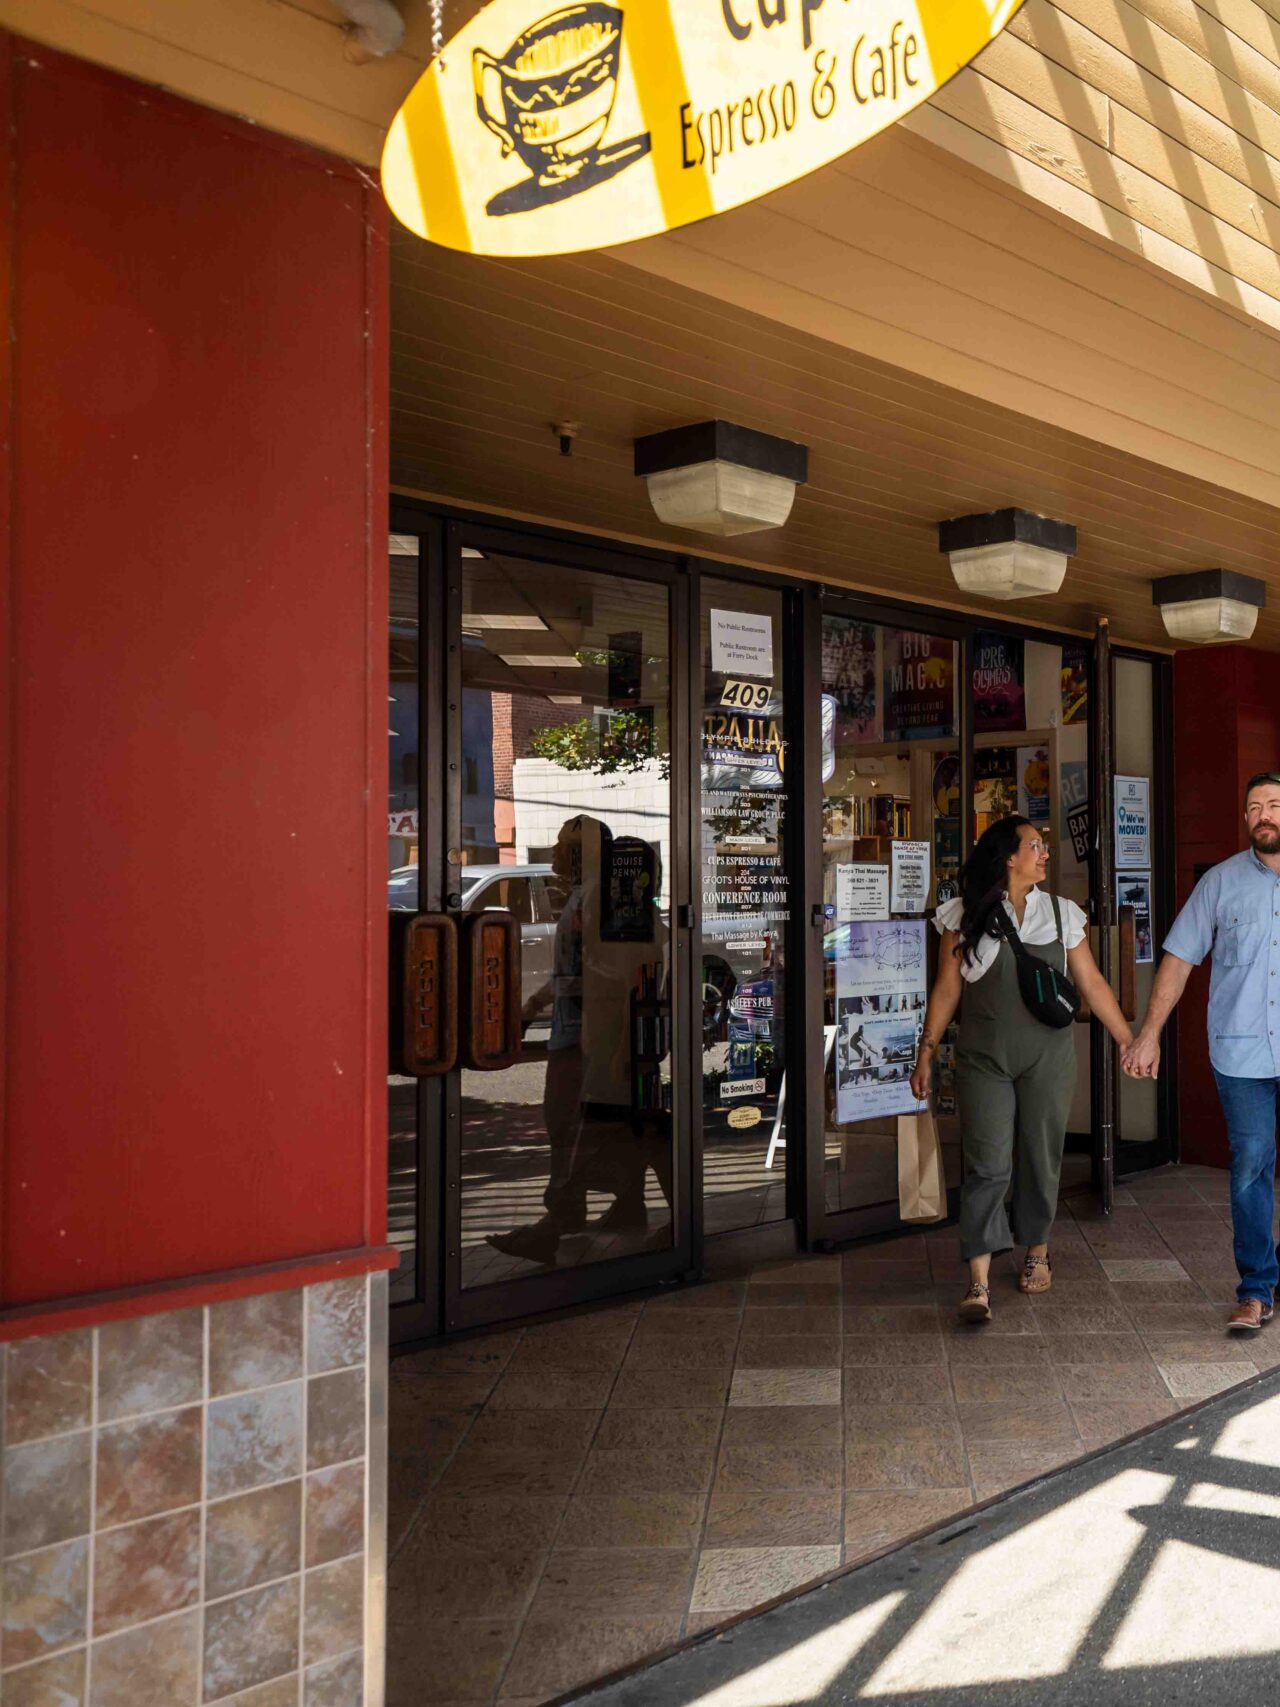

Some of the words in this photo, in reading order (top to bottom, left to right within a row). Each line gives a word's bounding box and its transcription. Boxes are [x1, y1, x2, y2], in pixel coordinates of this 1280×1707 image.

[679, 80, 796, 175] Espresso
[811, 50, 836, 120] &
[852, 21, 919, 105] Cafe
[726, 623, 741, 631] Public
[720, 641, 735, 650] Public
[903, 633, 931, 660] BIG
[980, 645, 1006, 669] LORE
[891, 662, 946, 692] MAGC
[723, 683, 769, 708] 409
[701, 808, 737, 818] WILLIAMSON
[738, 809, 750, 818] LAW
[1126, 814, 1144, 824] We've
[1119, 824, 1147, 836] MOVED!
[612, 856, 645, 867] LOUISE
[708, 856, 724, 866] CUPS
[726, 856, 758, 866] ESPRESSO
[734, 877, 757, 885] HOUSE
[759, 877, 769, 885] OF
[770, 877, 790, 885] VINYL
[703, 891, 760, 904] CONFERENCE
[762, 891, 787, 903] ROOM
[712, 932, 724, 940] Thai
[725, 931, 749, 941] Massage
[750, 931, 758, 941] by
[726, 998, 757, 1010] ASHLEY'S
[759, 997, 772, 1008] PUB
[721, 1086, 729, 1095] No
[730, 1084, 754, 1094] Smoking
